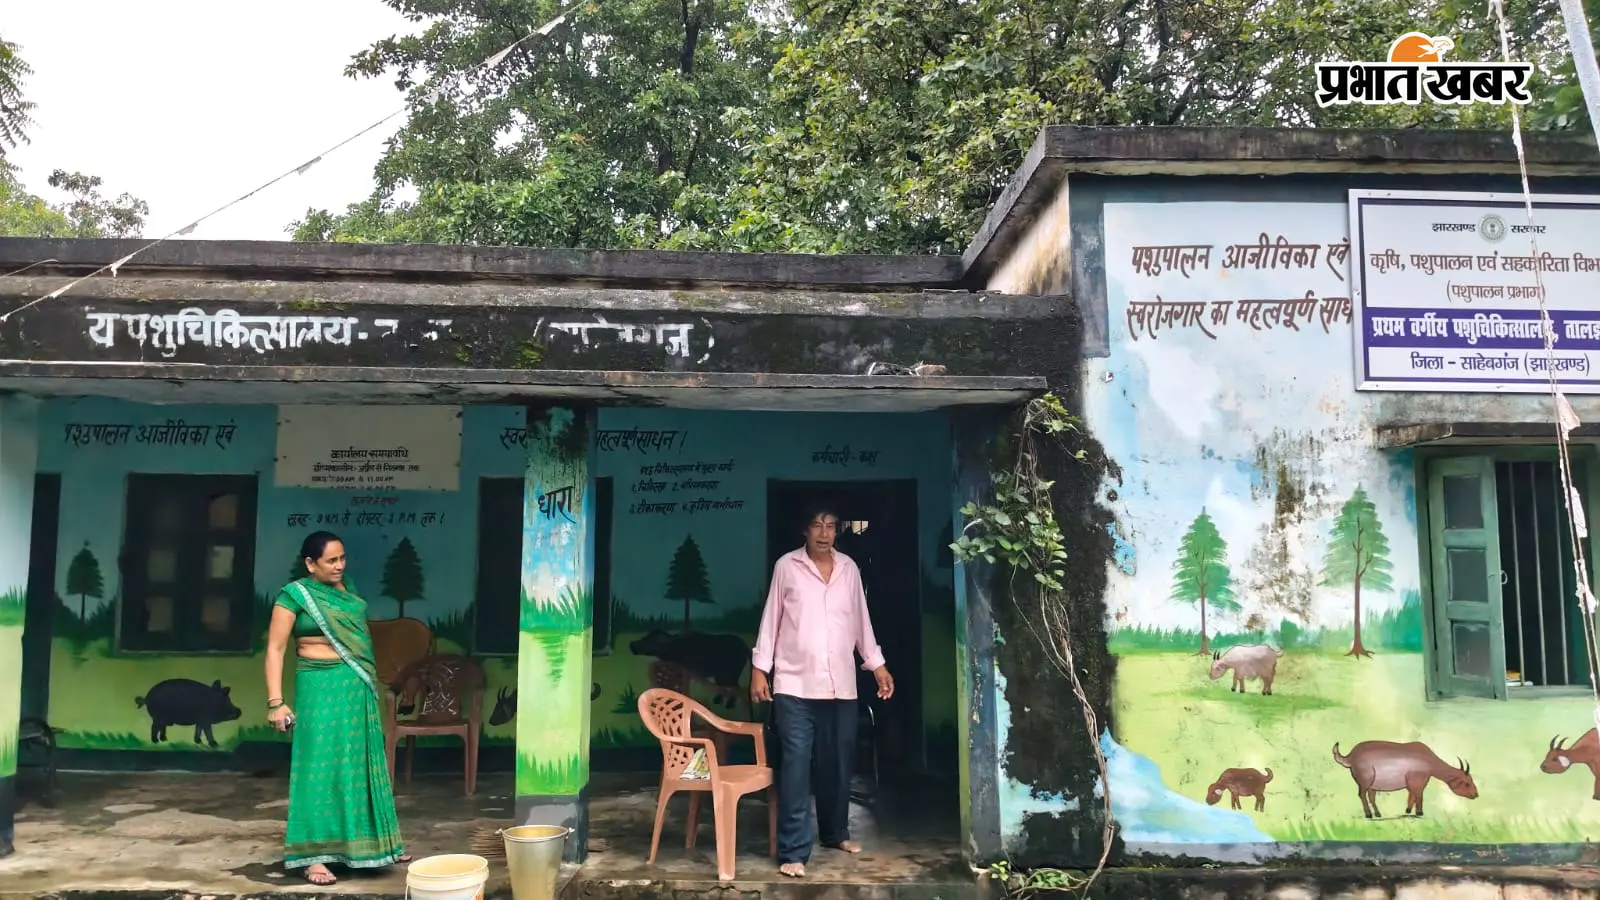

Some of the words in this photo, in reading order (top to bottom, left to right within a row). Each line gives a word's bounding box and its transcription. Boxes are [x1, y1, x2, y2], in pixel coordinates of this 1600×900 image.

[1432, 223, 1476, 232] झारखण्ड
[1511, 224, 1546, 234] सरकार
[1132, 245, 1214, 279] पशुपालन
[1222, 232, 1321, 269] आजीविका
[1326, 236, 1350, 281] एवं
[1370, 248, 1405, 274] कृषि,
[1410, 254, 1473, 275] पशुपालन
[1477, 250, 1498, 272] एवं
[1501, 250, 1569, 272] सहकारिता
[1446, 280, 1503, 303] (पशुपालन
[1507, 281, 1546, 303] प्रभाग)
[1126, 295, 1217, 341] स्वरोजगार
[1210, 301, 1234, 325] का
[1236, 290, 1320, 331] महत्वपूर्ण
[1371, 317, 1405, 337] प्रथम
[1409, 312, 1448, 337] वर्गीय
[1411, 351, 1444, 370] जिला
[1461, 352, 1519, 371] साहेबगंज
[136, 418, 211, 447] आजीविका
[330, 446, 368, 459] कार्यालय
[538, 485, 577, 524] धारा
